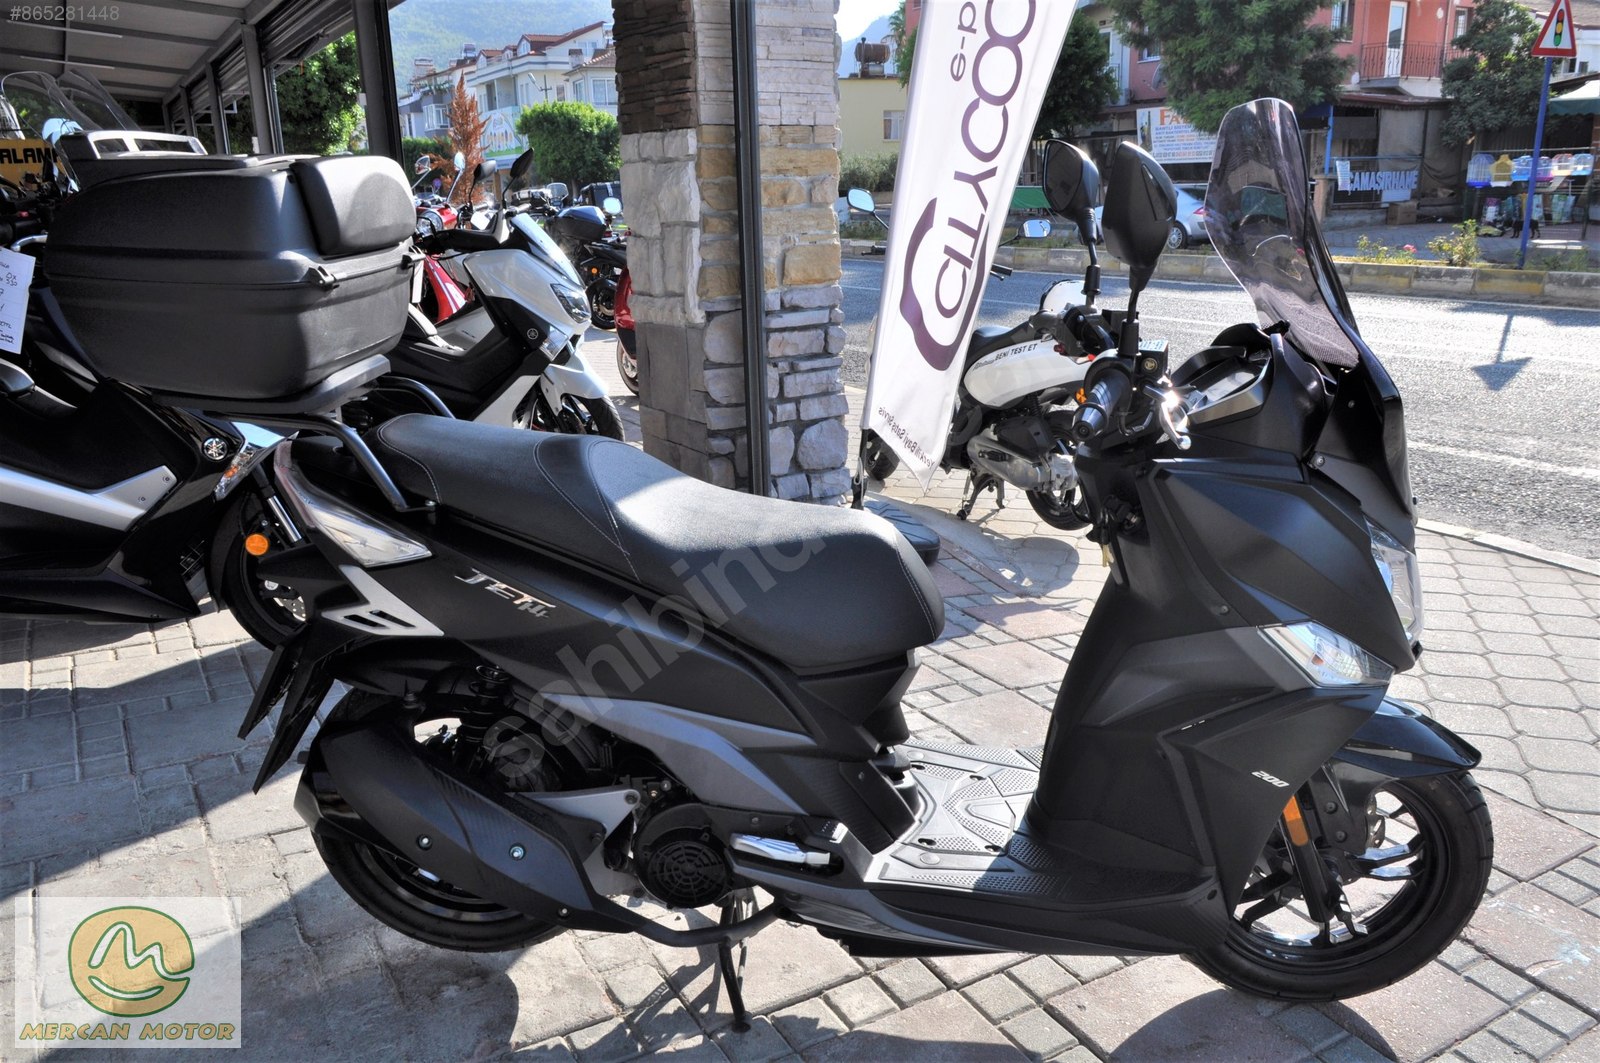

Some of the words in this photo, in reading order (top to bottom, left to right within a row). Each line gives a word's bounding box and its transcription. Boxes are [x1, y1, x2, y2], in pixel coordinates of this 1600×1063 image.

[1011, 345, 1027, 356] TEST
[1028, 343, 1038, 352] ET
[1251, 770, 1290, 788] 200
